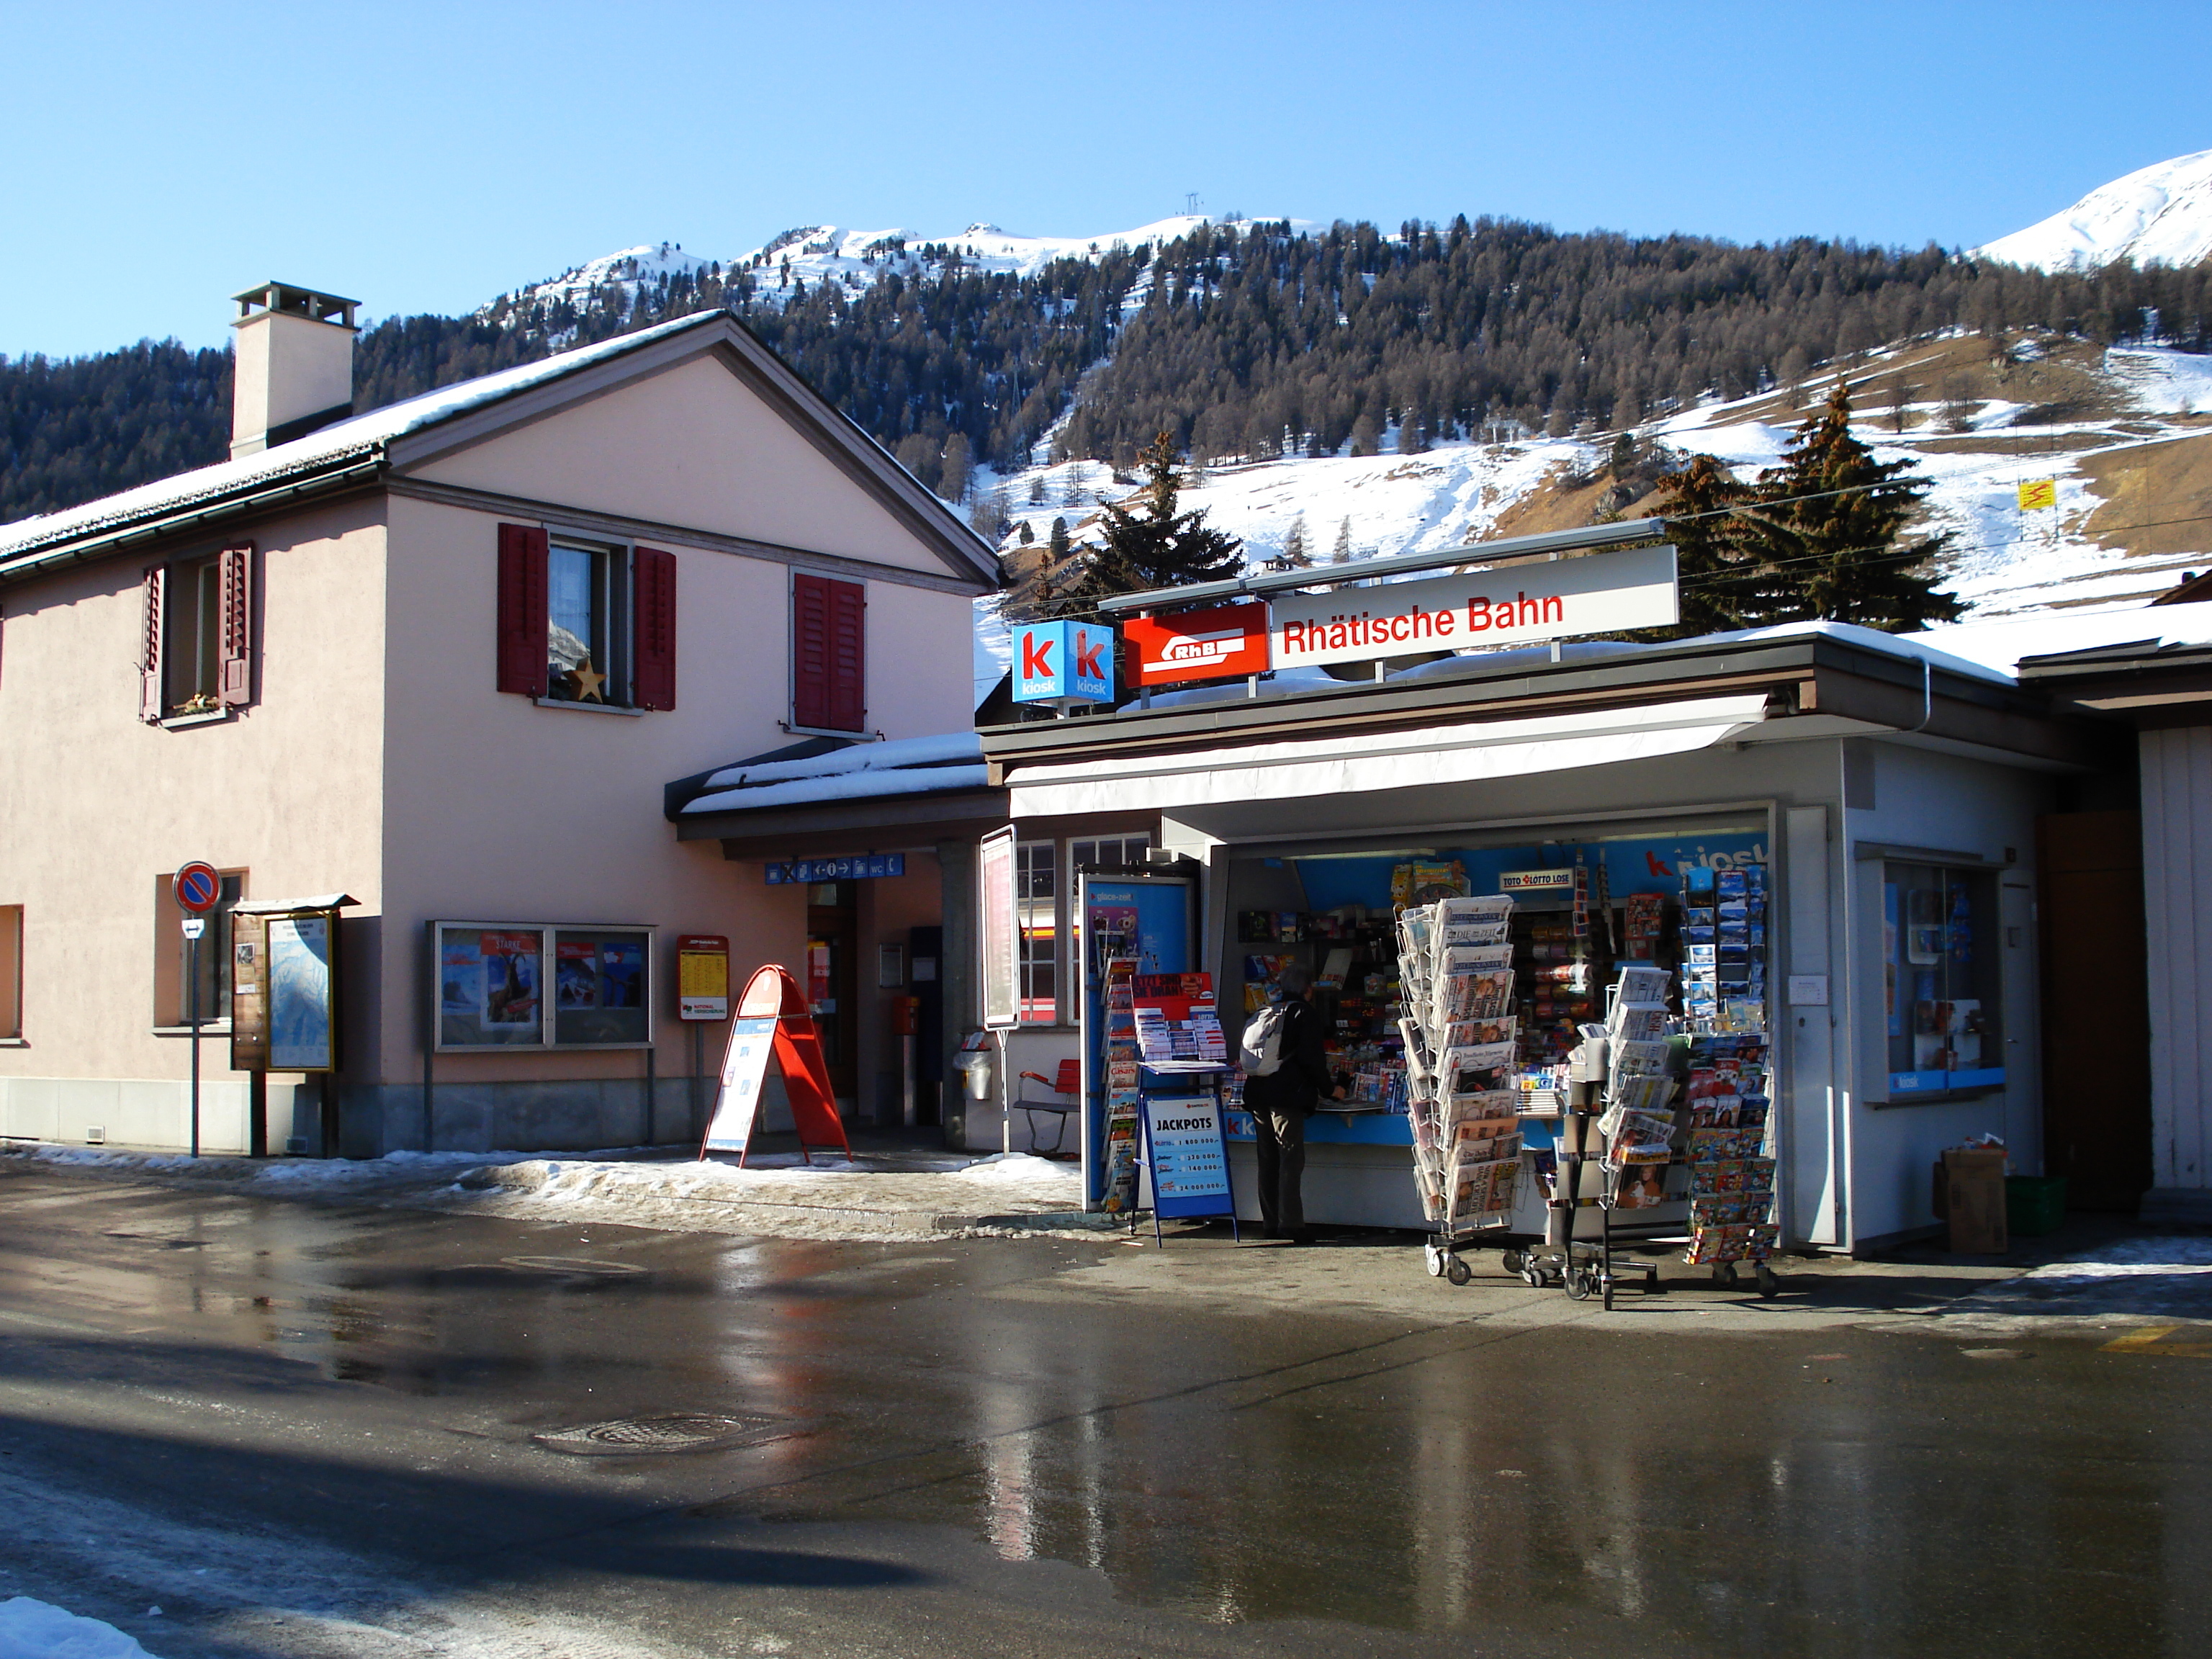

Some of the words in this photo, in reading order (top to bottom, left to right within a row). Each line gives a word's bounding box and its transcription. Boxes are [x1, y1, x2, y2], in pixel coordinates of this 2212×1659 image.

[1283, 605, 1454, 655] Rhätische
[1468, 591, 1563, 632] Bahn
[1022, 631, 1055, 680] k
[1077, 629, 1106, 680] k
[1175, 642, 1218, 660] RhB
[1022, 680, 1056, 696] kiosk
[1077, 679, 1106, 696] kiosk
[1503, 877, 1521, 886] TOTO
[1529, 875, 1551, 884] LOTTO
[1553, 874, 1569, 883] LOSE
[1156, 1117, 1212, 1131] JACKPOTS
